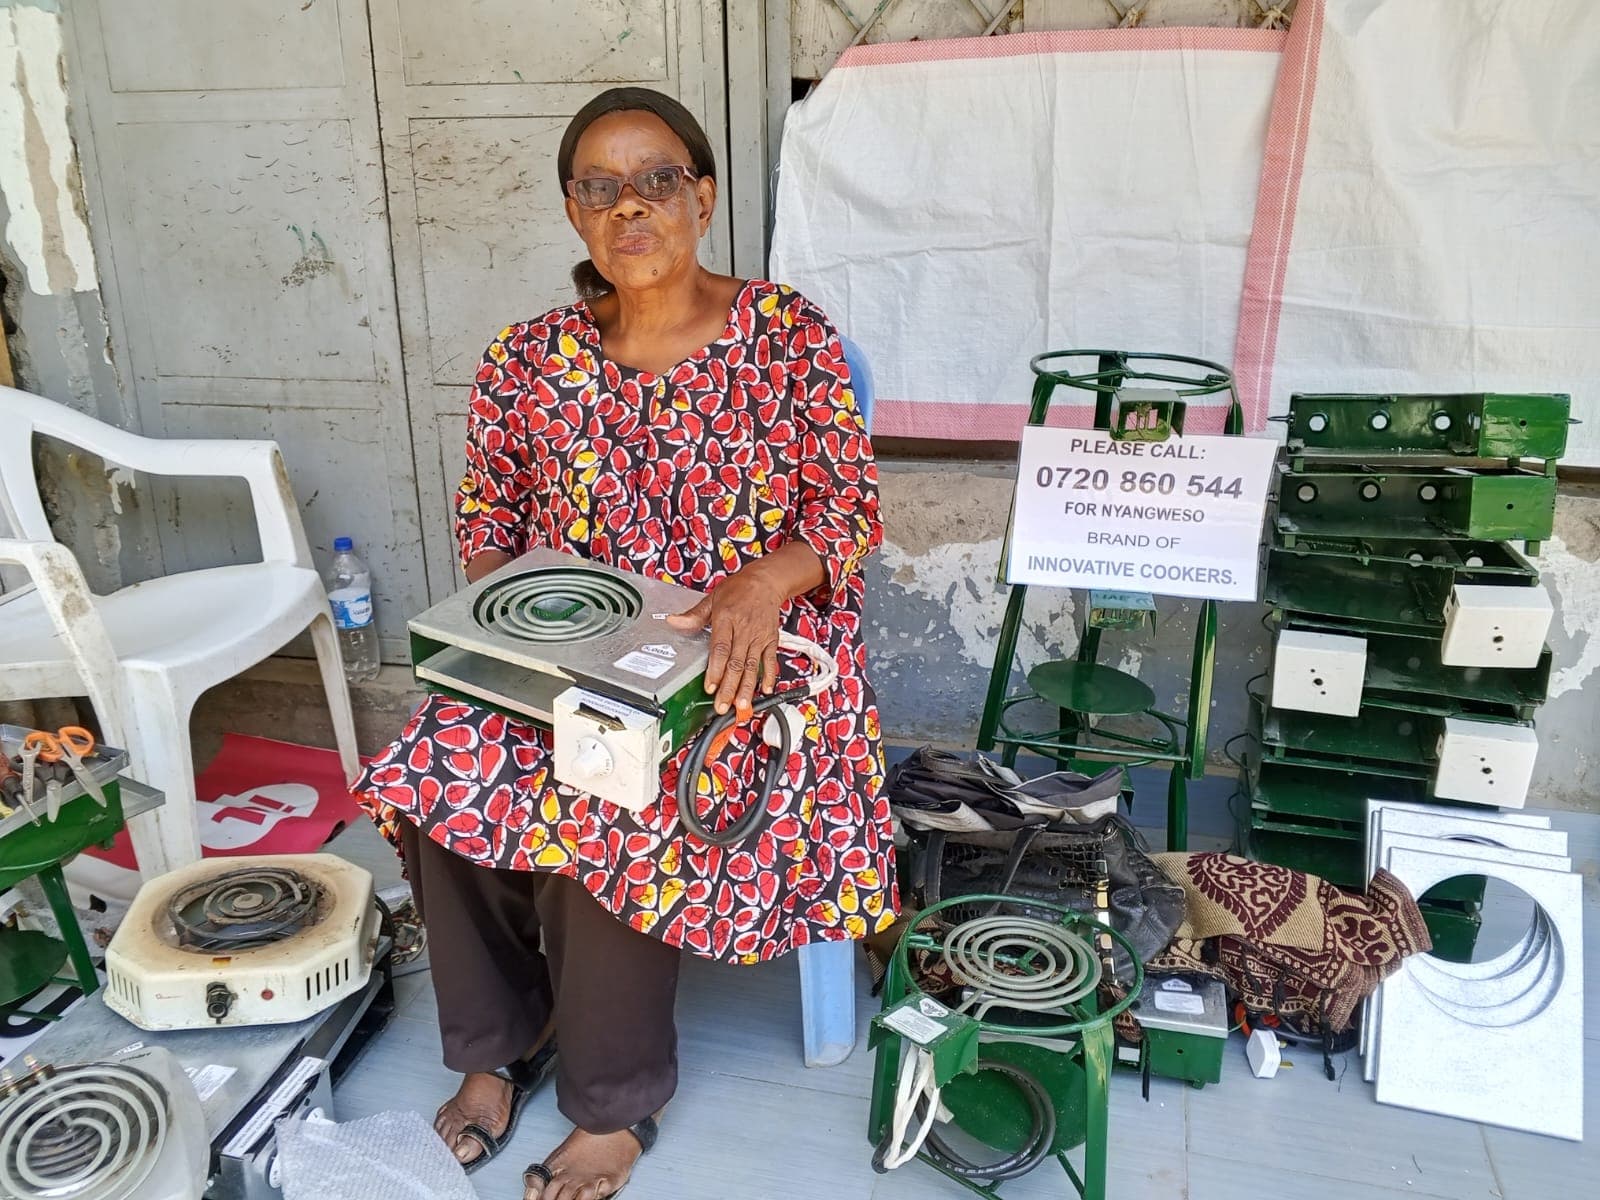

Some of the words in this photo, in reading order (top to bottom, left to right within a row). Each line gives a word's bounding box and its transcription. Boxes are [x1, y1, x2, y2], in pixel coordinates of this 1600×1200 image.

[1070, 439, 1144, 456] PLEASE
[1150, 443, 1206, 459] CALL:
[1036, 466, 1109, 491] 0720
[1119, 471, 1175, 495] 860
[1187, 475, 1242, 499] 544
[1064, 501, 1097, 516] FOR
[1101, 504, 1205, 522] NYANGWESO
[1087, 532, 1150, 547] BRAND
[1155, 537, 1181, 549] OF
[1028, 555, 1134, 577] INNOVATIVE
[1140, 564, 1237, 585] COOKERS.
